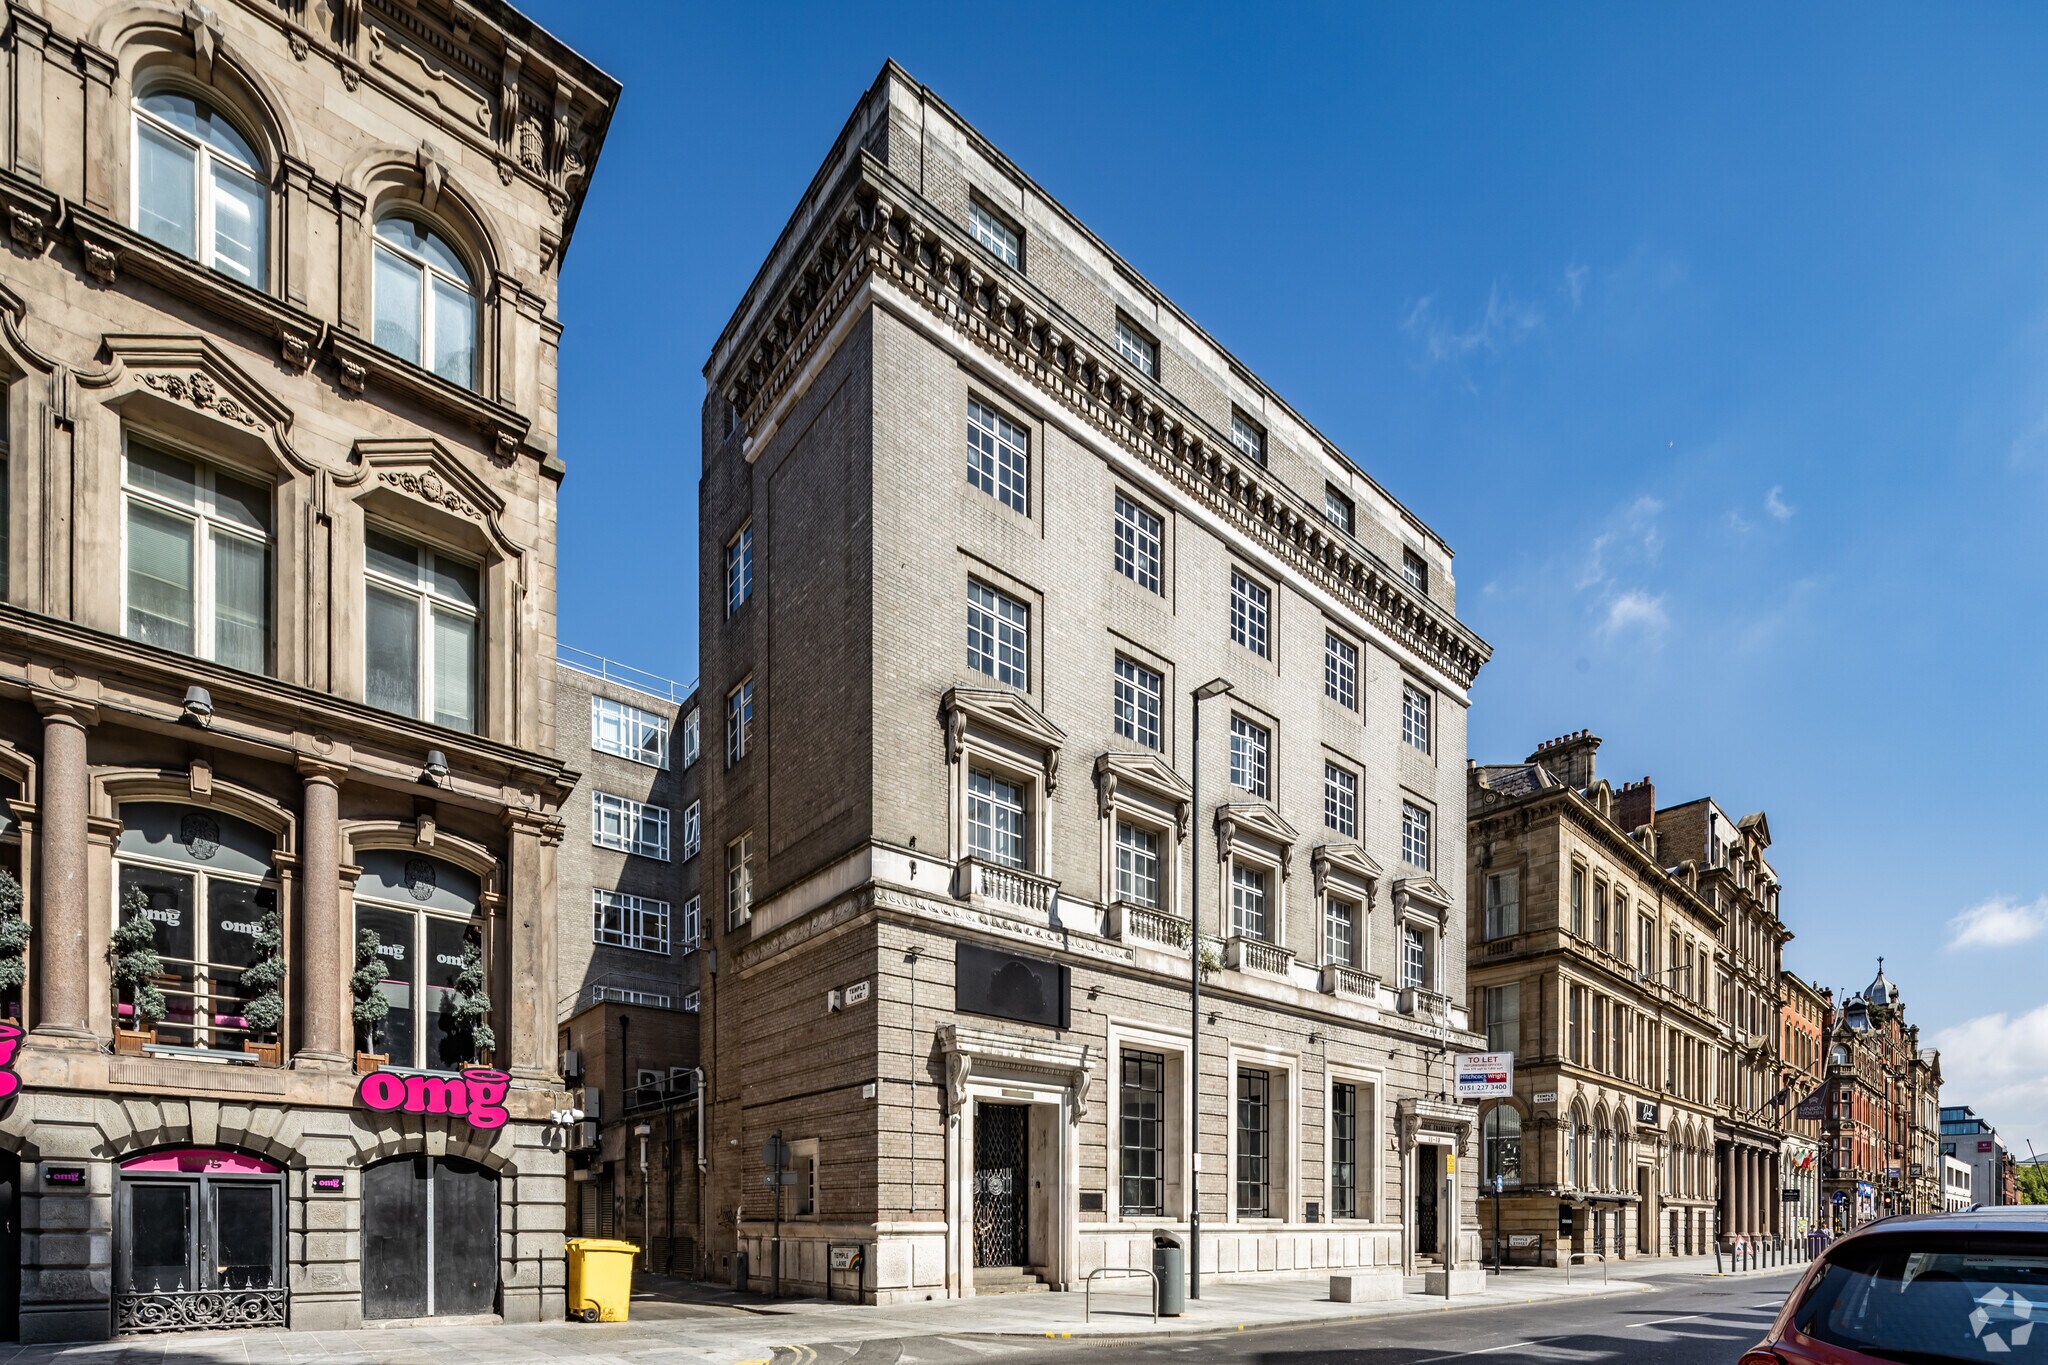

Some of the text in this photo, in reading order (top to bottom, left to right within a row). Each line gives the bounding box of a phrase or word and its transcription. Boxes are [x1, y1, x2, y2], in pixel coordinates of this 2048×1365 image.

[221, 920, 263, 938] omg
[378, 944, 405, 960] mg
[849, 984, 866, 994] TEMPLE
[851, 993, 862, 1001] LANE
[359, 1068, 512, 1129] omg
[53, 1172, 80, 1182] omg
[319, 1178, 340, 1188] omg
